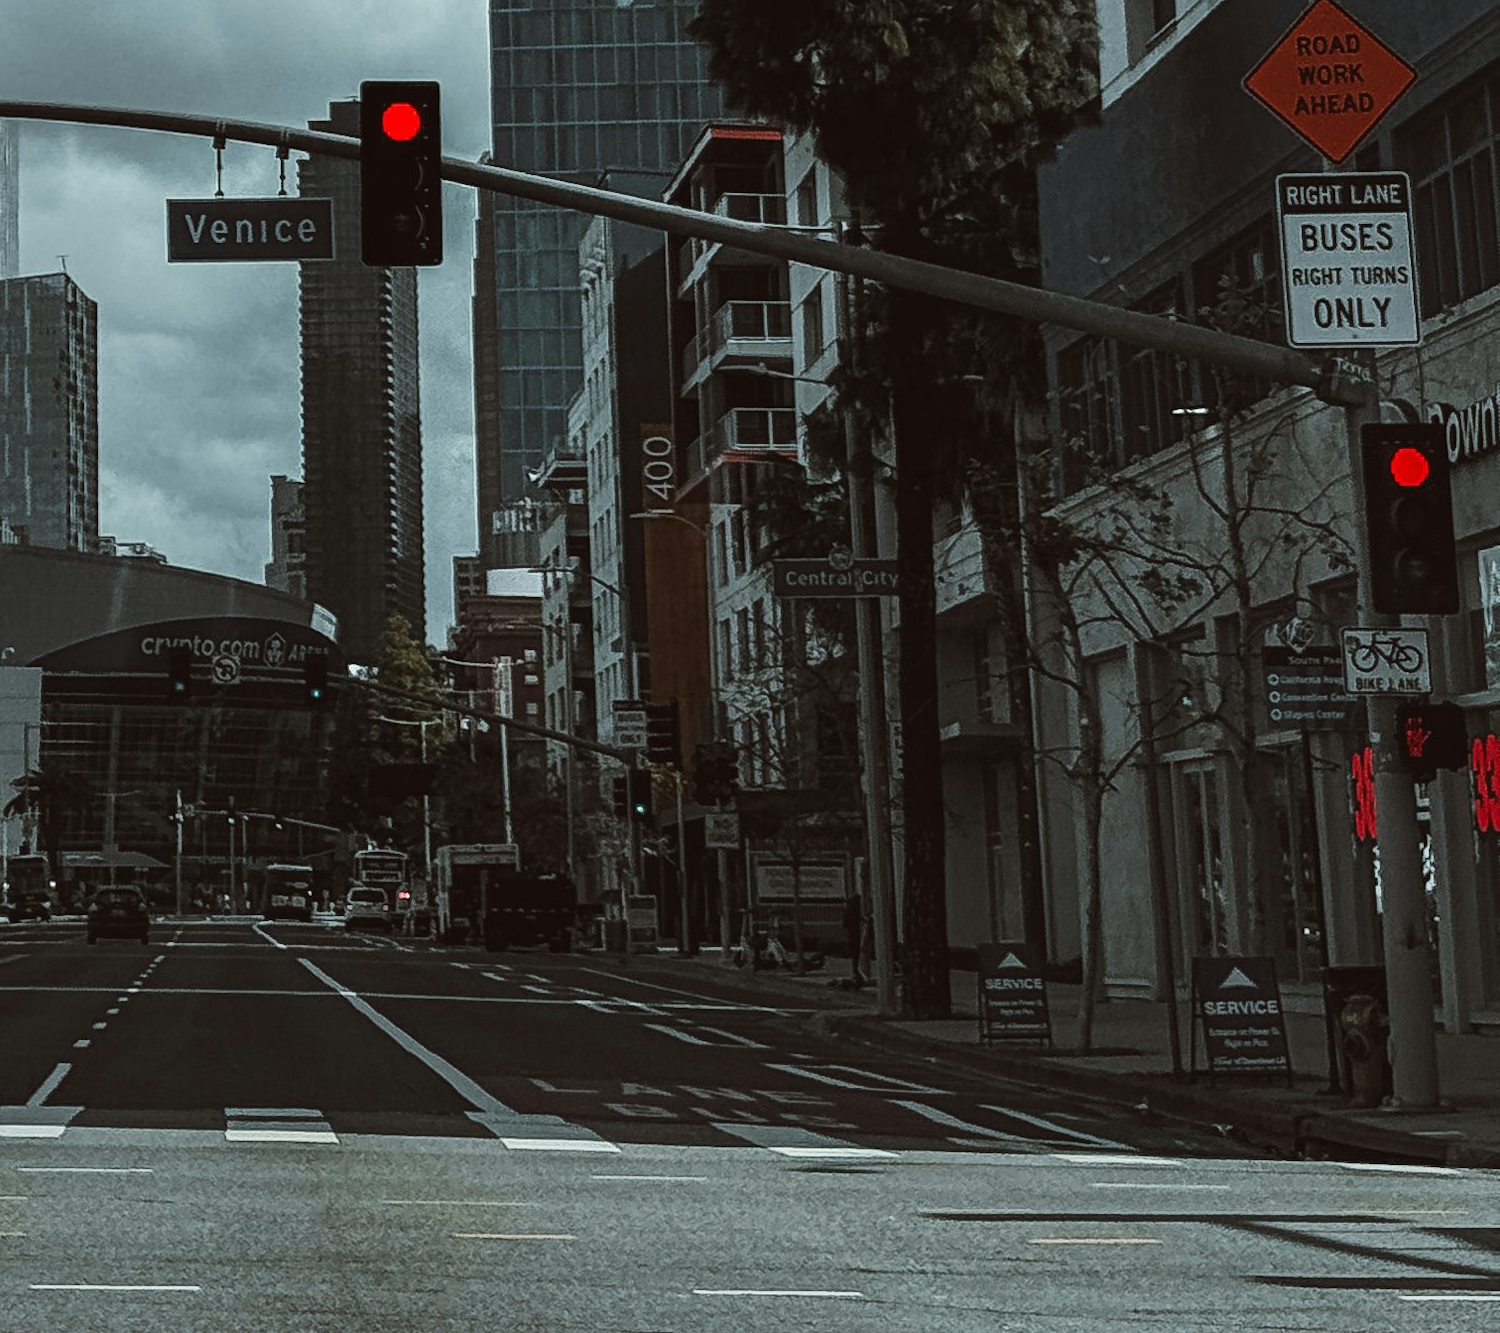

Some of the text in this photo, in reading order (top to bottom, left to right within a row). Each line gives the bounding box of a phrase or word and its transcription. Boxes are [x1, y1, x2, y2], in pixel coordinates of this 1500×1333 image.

[1296, 34, 1361, 57] ROAD
[1299, 63, 1364, 87] WORK
[1295, 93, 1375, 117] AHEAD
[1286, 181, 1402, 206] RIGHT LANE
[184, 213, 317, 244] Venice
[1301, 222, 1394, 253] BUSES
[1292, 265, 1409, 287] RIGHT TURNS
[1312, 296, 1393, 329] ONLY
[643, 436, 676, 513] 1400
[786, 570, 900, 588] Central City
[1355, 677, 1422, 692] BIKE LANE
[984, 978, 1044, 990] SERVICE
[1203, 1000, 1280, 1015] SERVICE
[527, 1077, 835, 1107] LANE
